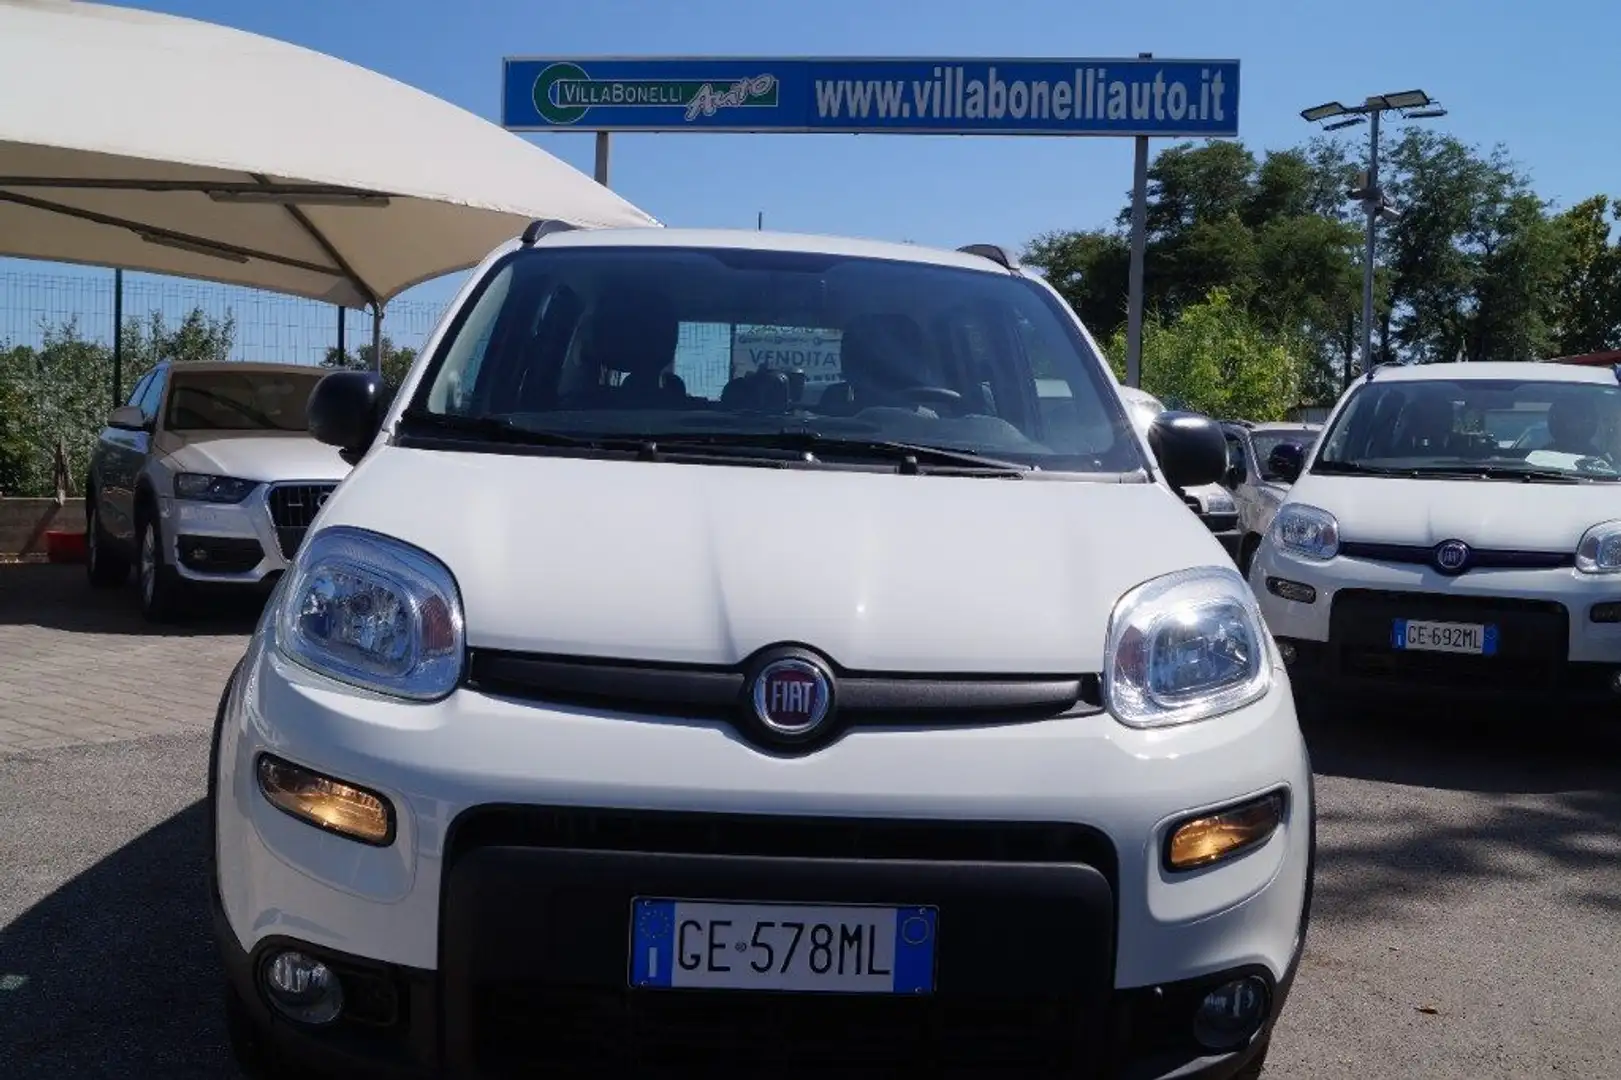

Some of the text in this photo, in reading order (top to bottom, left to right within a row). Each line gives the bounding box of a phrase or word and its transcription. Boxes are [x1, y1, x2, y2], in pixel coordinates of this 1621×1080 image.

[684, 73, 774, 122] Auto
[815, 66, 1225, 121] www.villabonelliauto.it
[771, 681, 814, 713] FIAT
